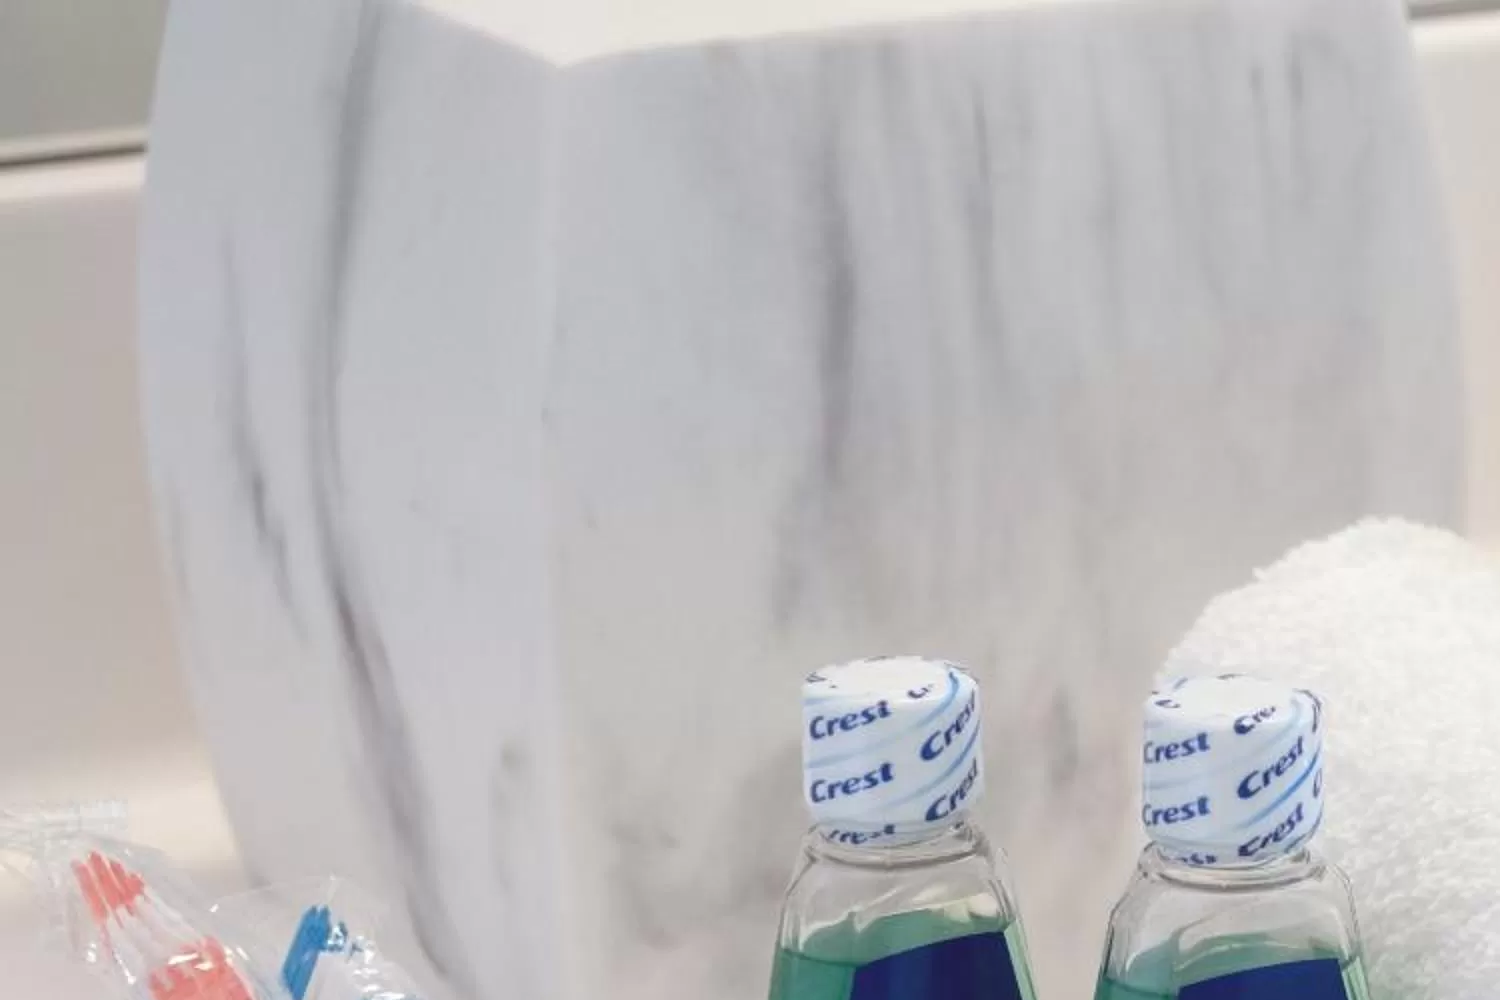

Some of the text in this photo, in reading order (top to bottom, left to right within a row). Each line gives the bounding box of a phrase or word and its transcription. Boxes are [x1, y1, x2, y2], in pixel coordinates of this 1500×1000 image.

[809, 700, 893, 740] Crest
[1143, 732, 1210, 764] Crest
[1237, 735, 1304, 799] Crest
[810, 762, 894, 803] Crest
[1142, 796, 1210, 828] Crest
[1237, 802, 1304, 856] Crest
